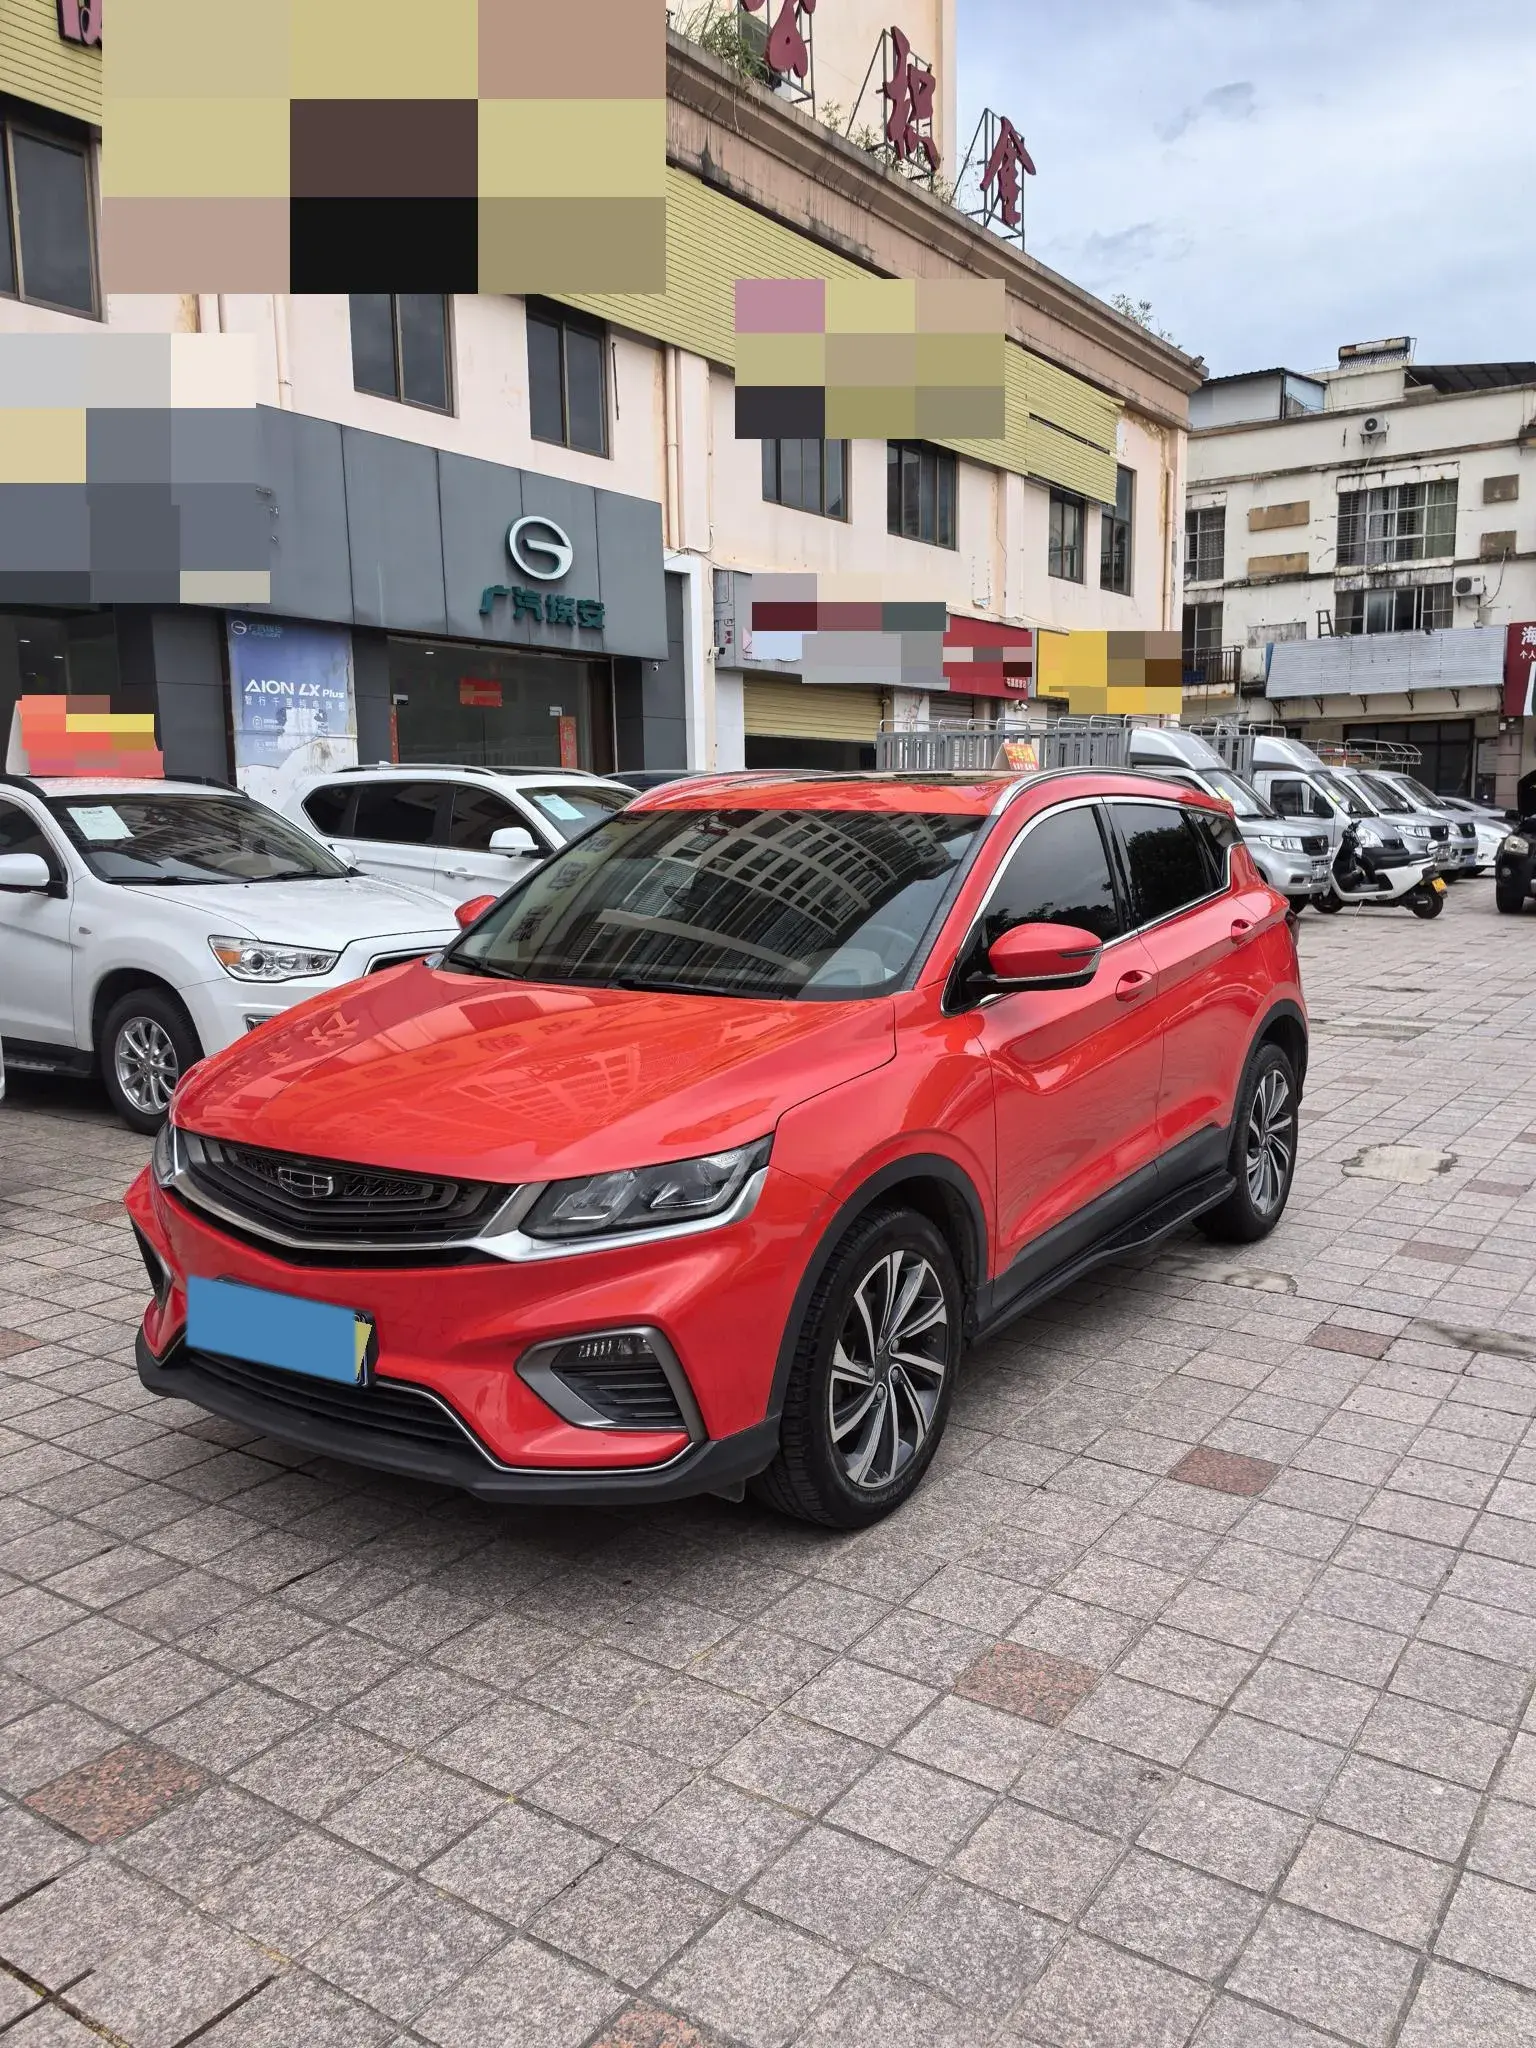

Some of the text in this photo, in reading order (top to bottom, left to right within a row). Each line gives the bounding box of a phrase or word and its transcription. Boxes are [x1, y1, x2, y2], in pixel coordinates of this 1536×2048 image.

[479, 585, 605, 629] 广汽埃安
[245, 679, 345, 699] AION LX Plus
